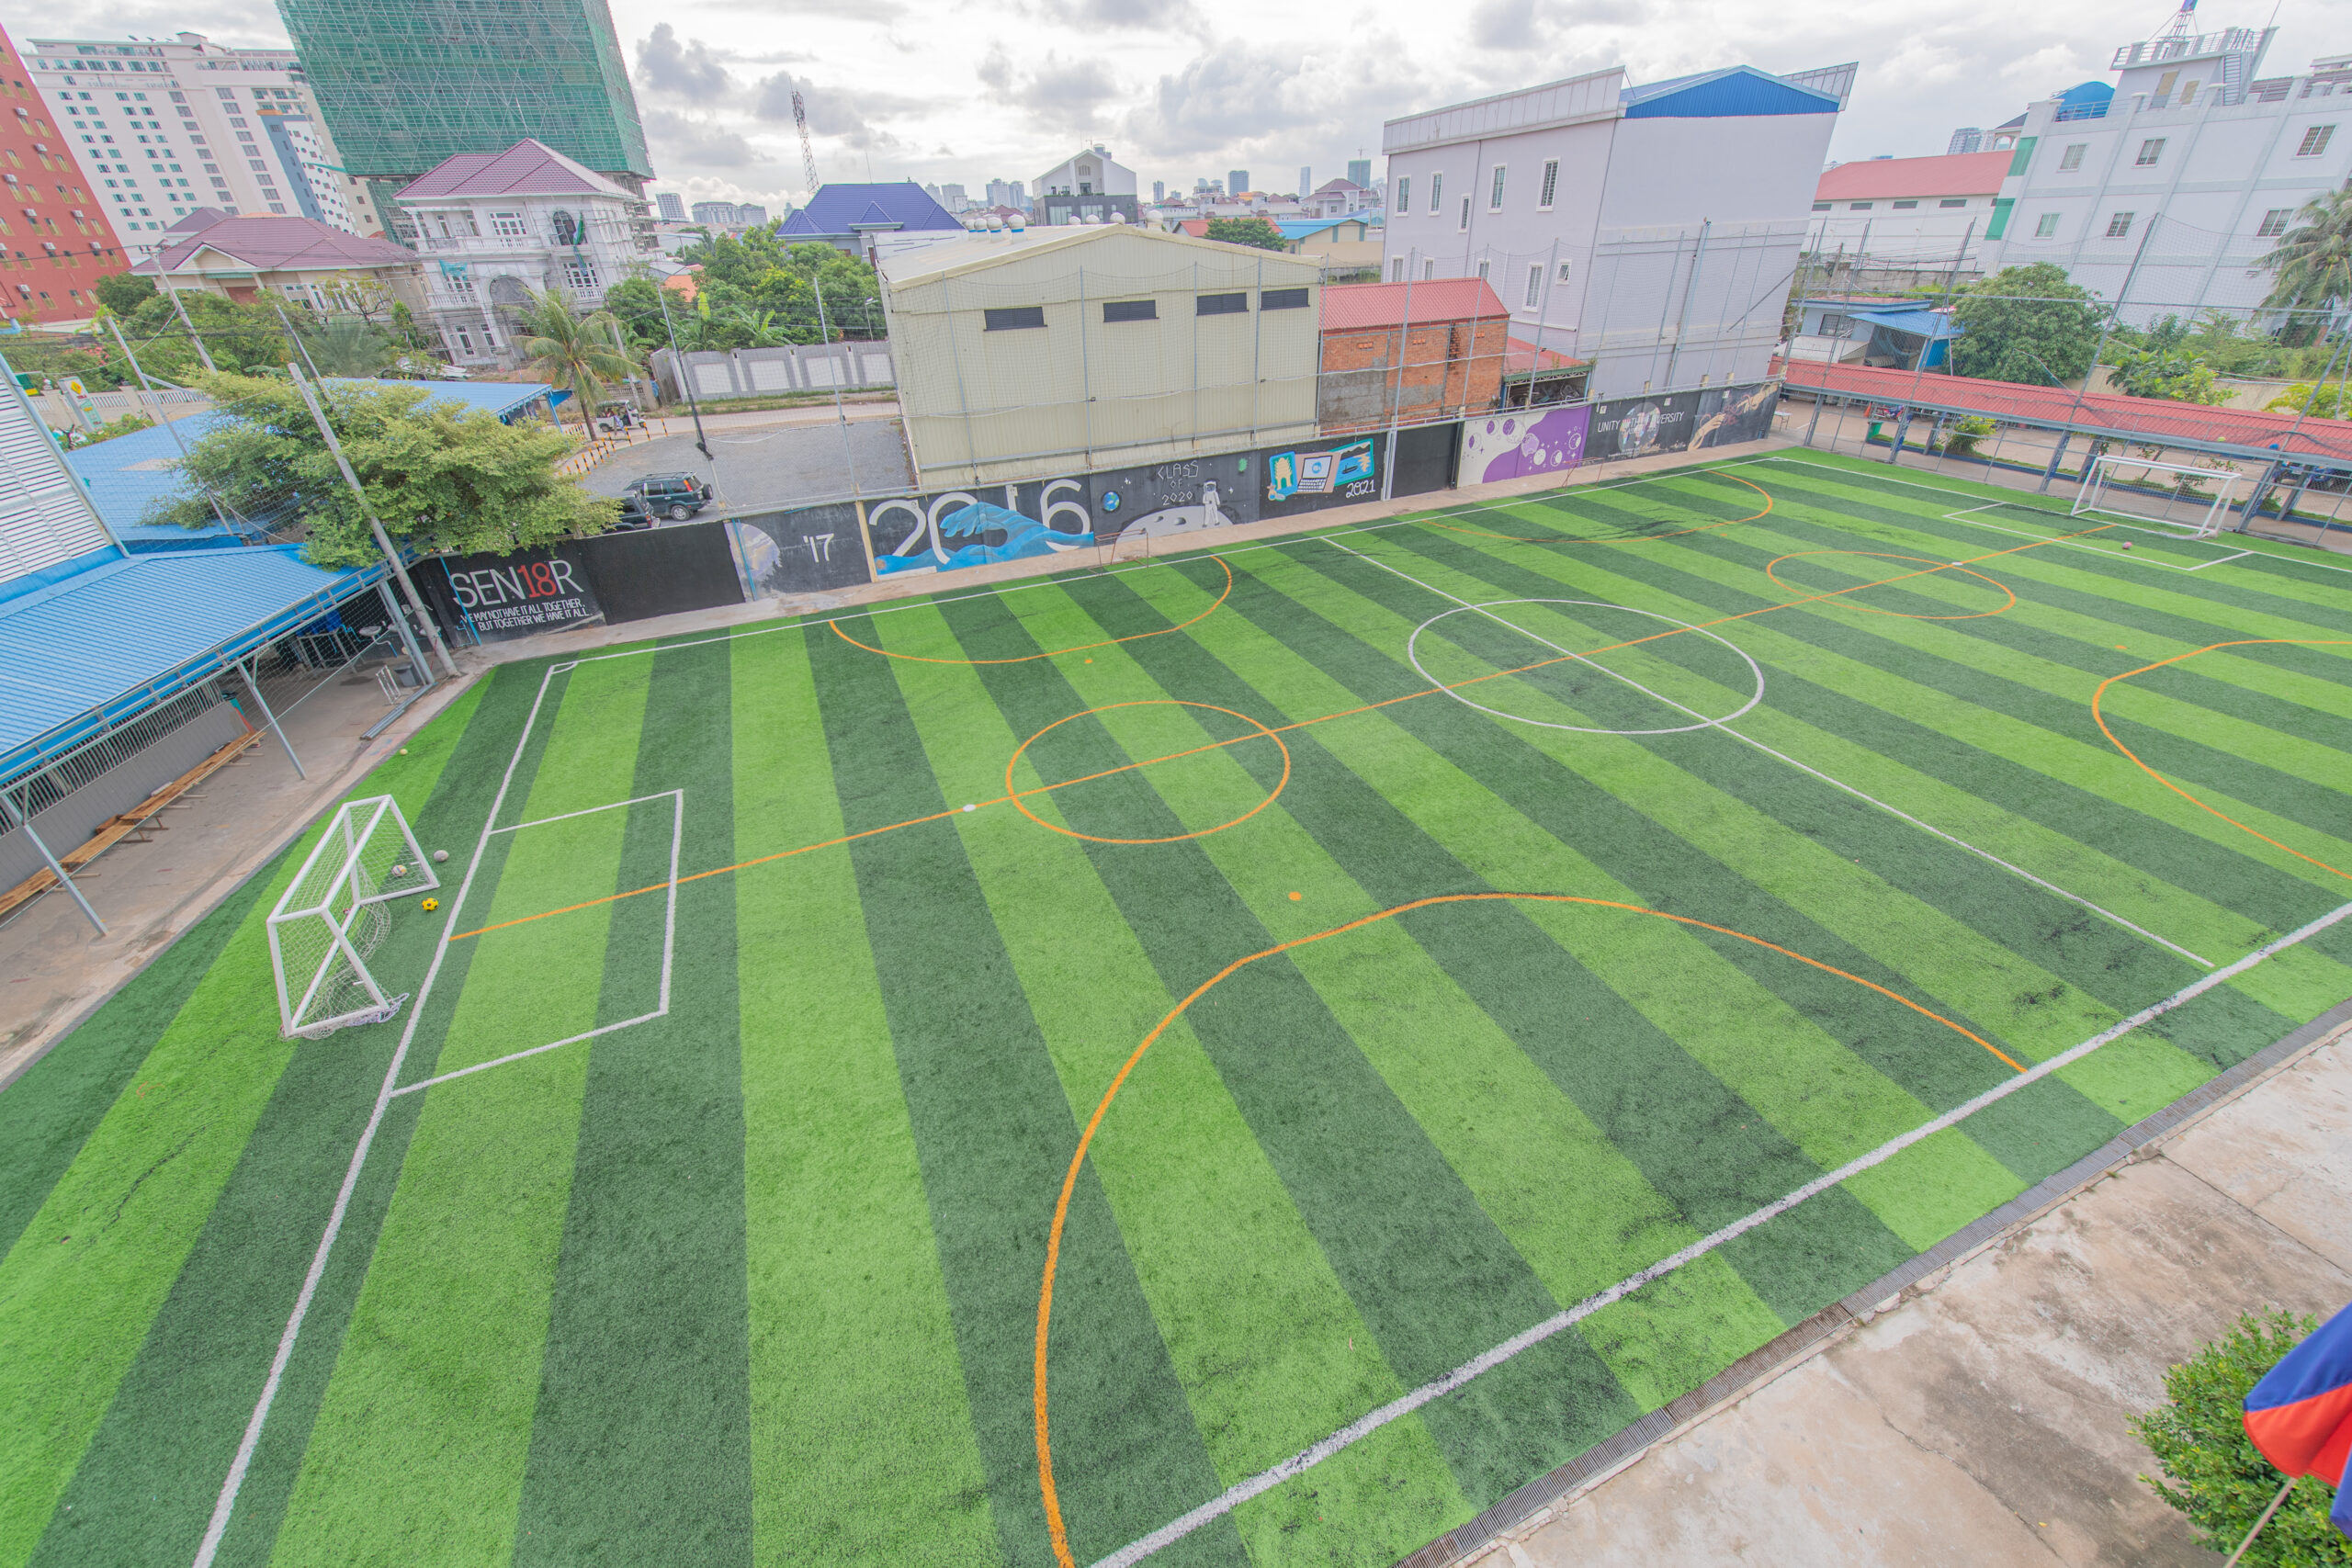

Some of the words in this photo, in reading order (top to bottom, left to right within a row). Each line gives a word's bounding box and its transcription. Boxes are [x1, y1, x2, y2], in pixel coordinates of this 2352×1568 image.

[1597, 420, 1622, 433] UNITY
[1158, 460, 1199, 479] CLASS
[1170, 479, 1183, 489] OF
[1345, 479, 1376, 499] 2021
[1161, 491, 1193, 506] 2020
[449, 559, 584, 608] SEN18R
[474, 611, 488, 622] MAY
[488, 608, 503, 620] NOT
[502, 606, 521, 618] HAVE
[520, 604, 529, 615] IT
[529, 604, 543, 615] ALL
[478, 621, 493, 631] BUT
[492, 615, 534, 629] TOGETHER
[532, 613, 547, 624] WE
[546, 610, 566, 622] HAVE
[564, 608, 572, 618] IT
